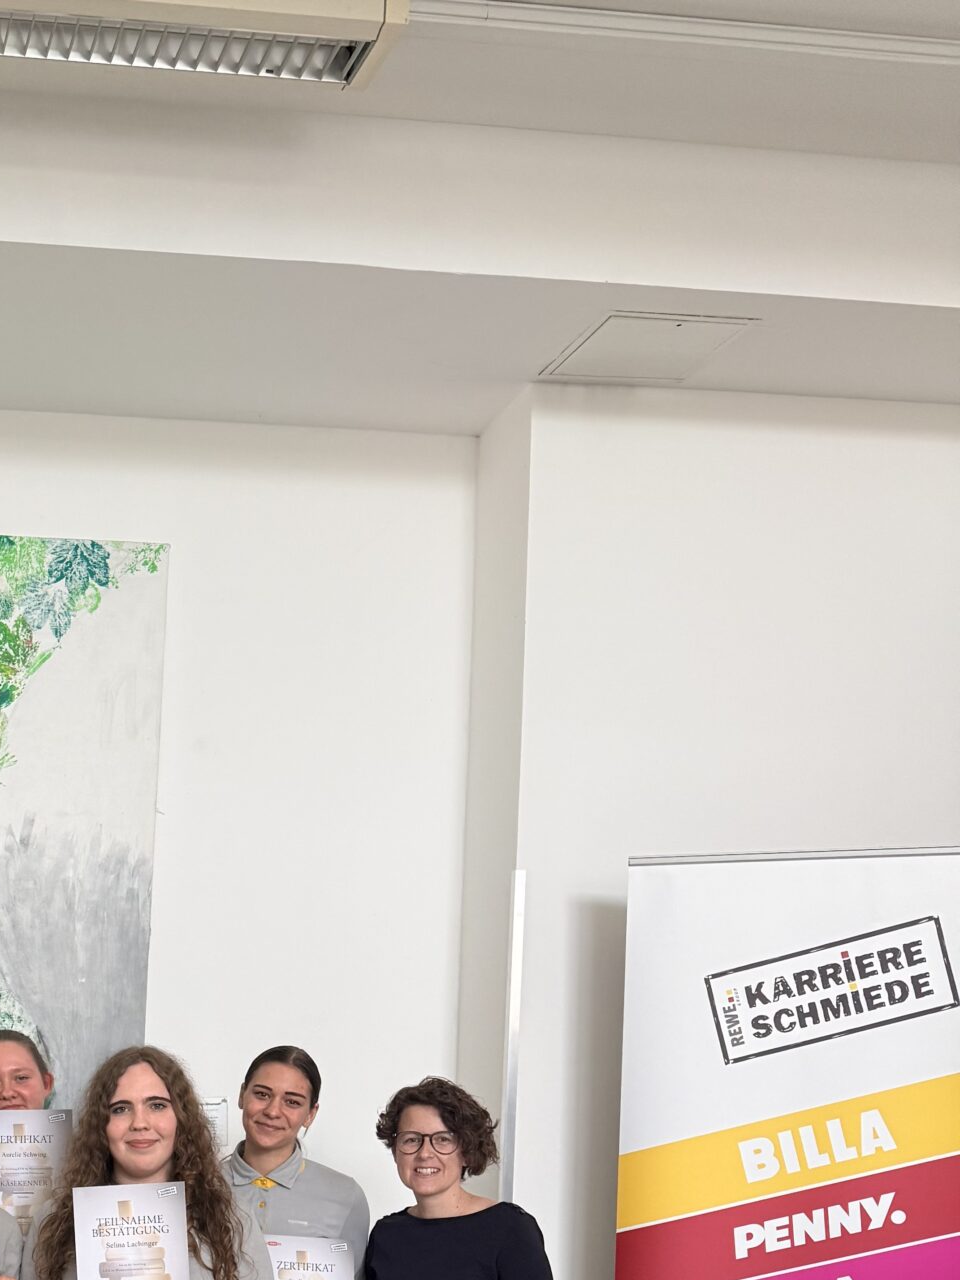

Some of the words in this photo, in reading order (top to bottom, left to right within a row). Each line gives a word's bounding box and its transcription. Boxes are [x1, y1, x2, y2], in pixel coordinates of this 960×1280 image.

[744, 940, 926, 1008] KARRIERE
[722, 1004, 745, 1047] REWE
[751, 972, 934, 1039] SCHMIEDE
[738, 1108, 897, 1184] BILLA
[92, 1225, 170, 1237] BESTÄTIGUNG
[96, 1215, 164, 1227] TEILNAHME
[733, 1191, 906, 1260] PENNY.
[276, 1260, 336, 1272] ZERTIFIKAT
